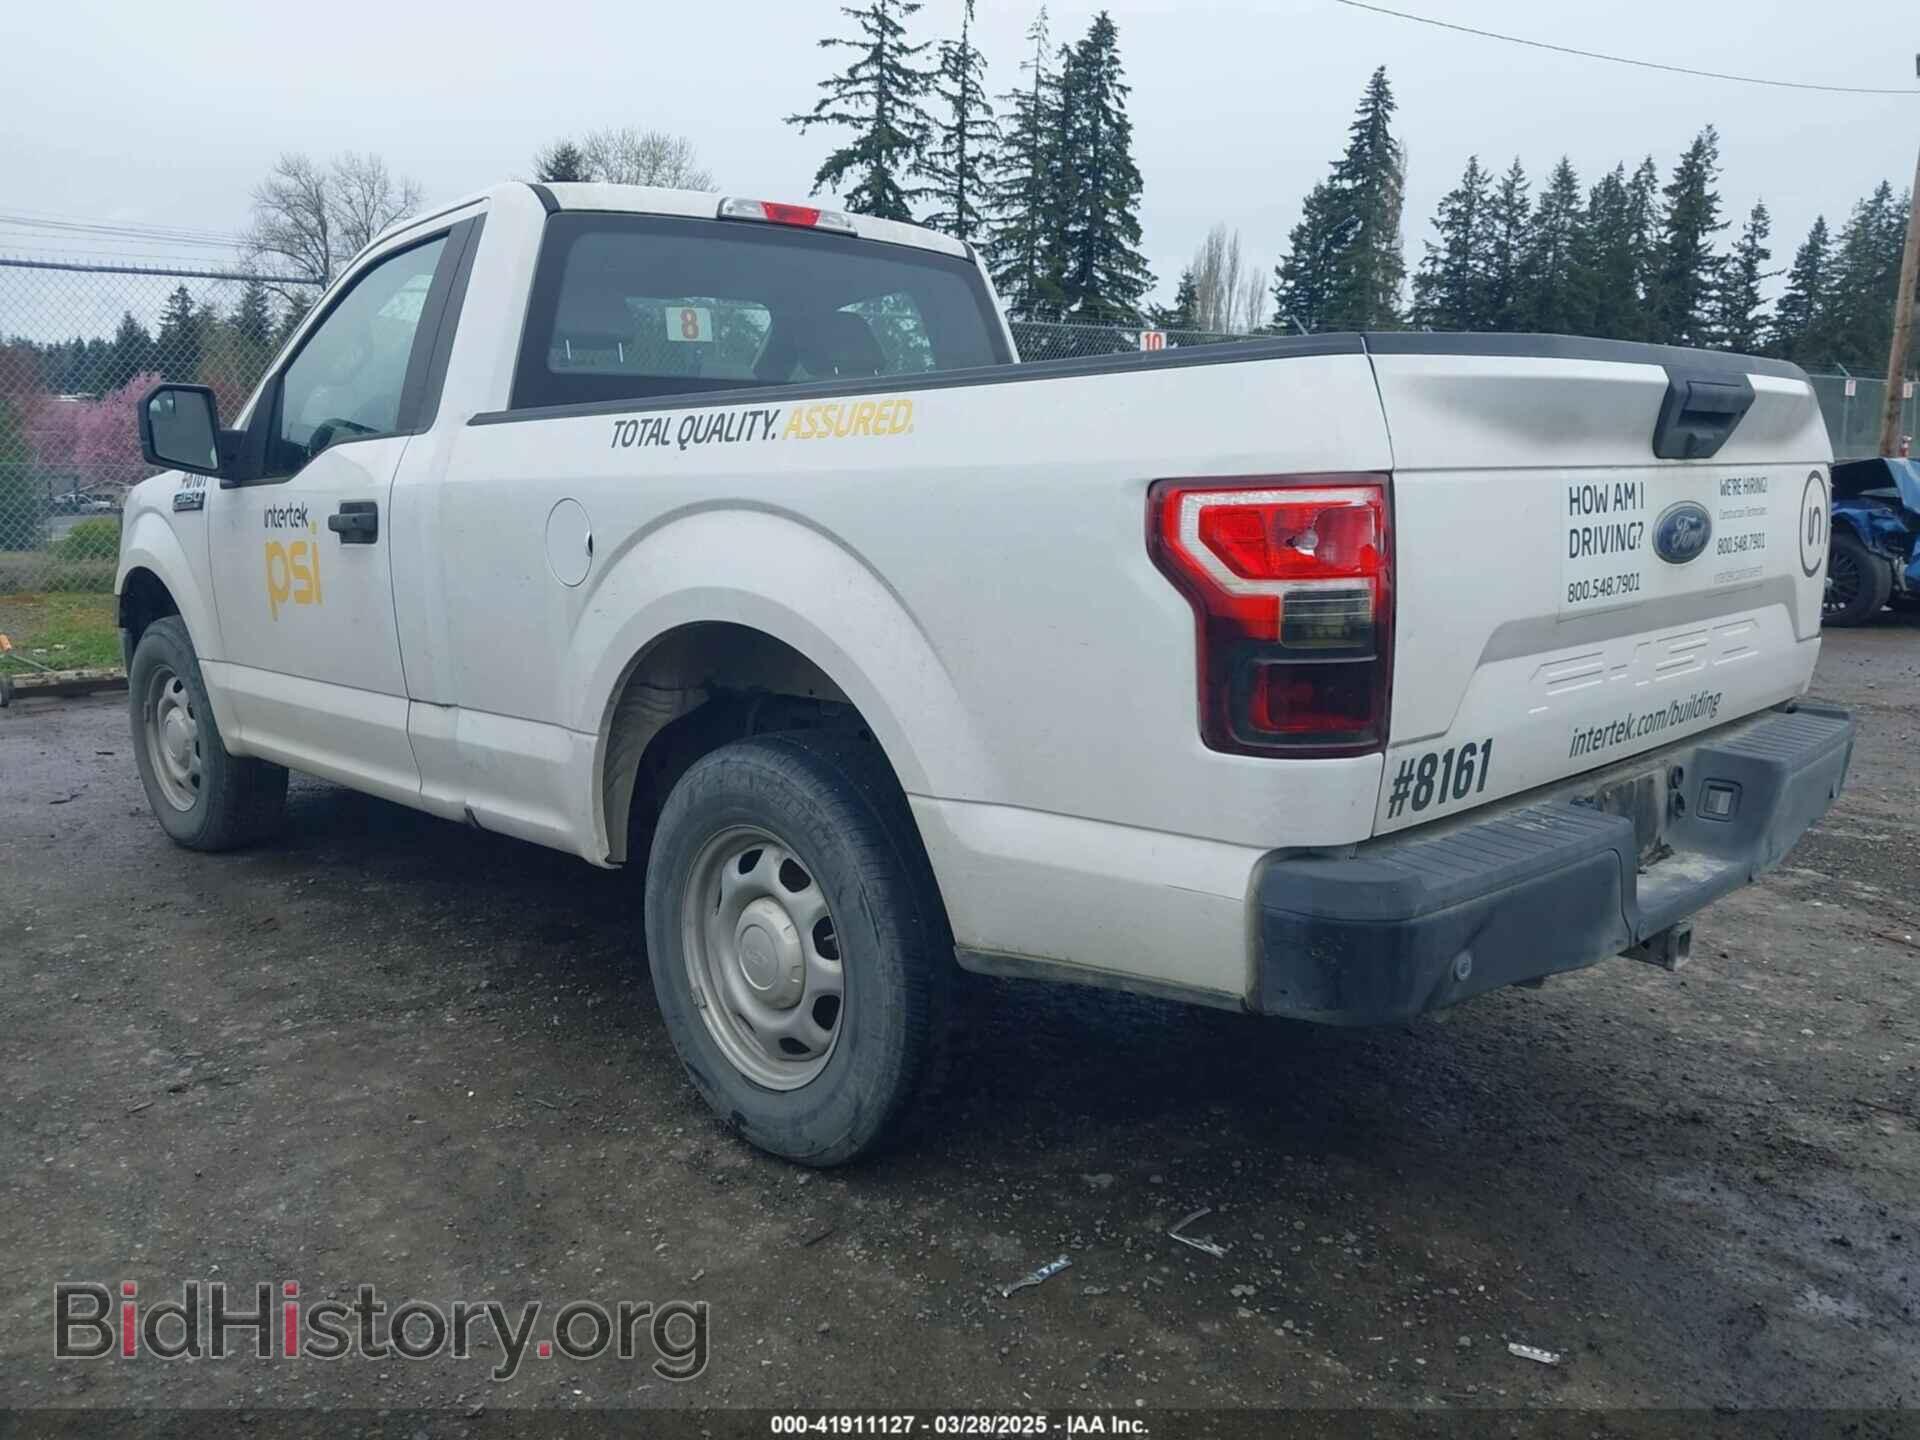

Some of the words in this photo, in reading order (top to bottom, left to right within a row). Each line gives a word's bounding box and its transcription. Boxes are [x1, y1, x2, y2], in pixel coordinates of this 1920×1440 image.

[681, 309, 699, 339] 8
[611, 418, 670, 449] TOTAL
[677, 409, 780, 451] QUALITY.
[782, 399, 914, 441] ASSURED.
[264, 502, 308, 528] intertek
[1569, 484, 1609, 516] HOW
[1612, 482, 1637, 511] AM
[1640, 481, 1644, 509] I
[1569, 522, 1644, 559] DRIVING?
[265, 521, 323, 622] psi
[1568, 573, 1640, 602] 800.548.7901
[1568, 691, 1722, 758] intertek.com/building
[1387, 738, 1494, 819] #8161
